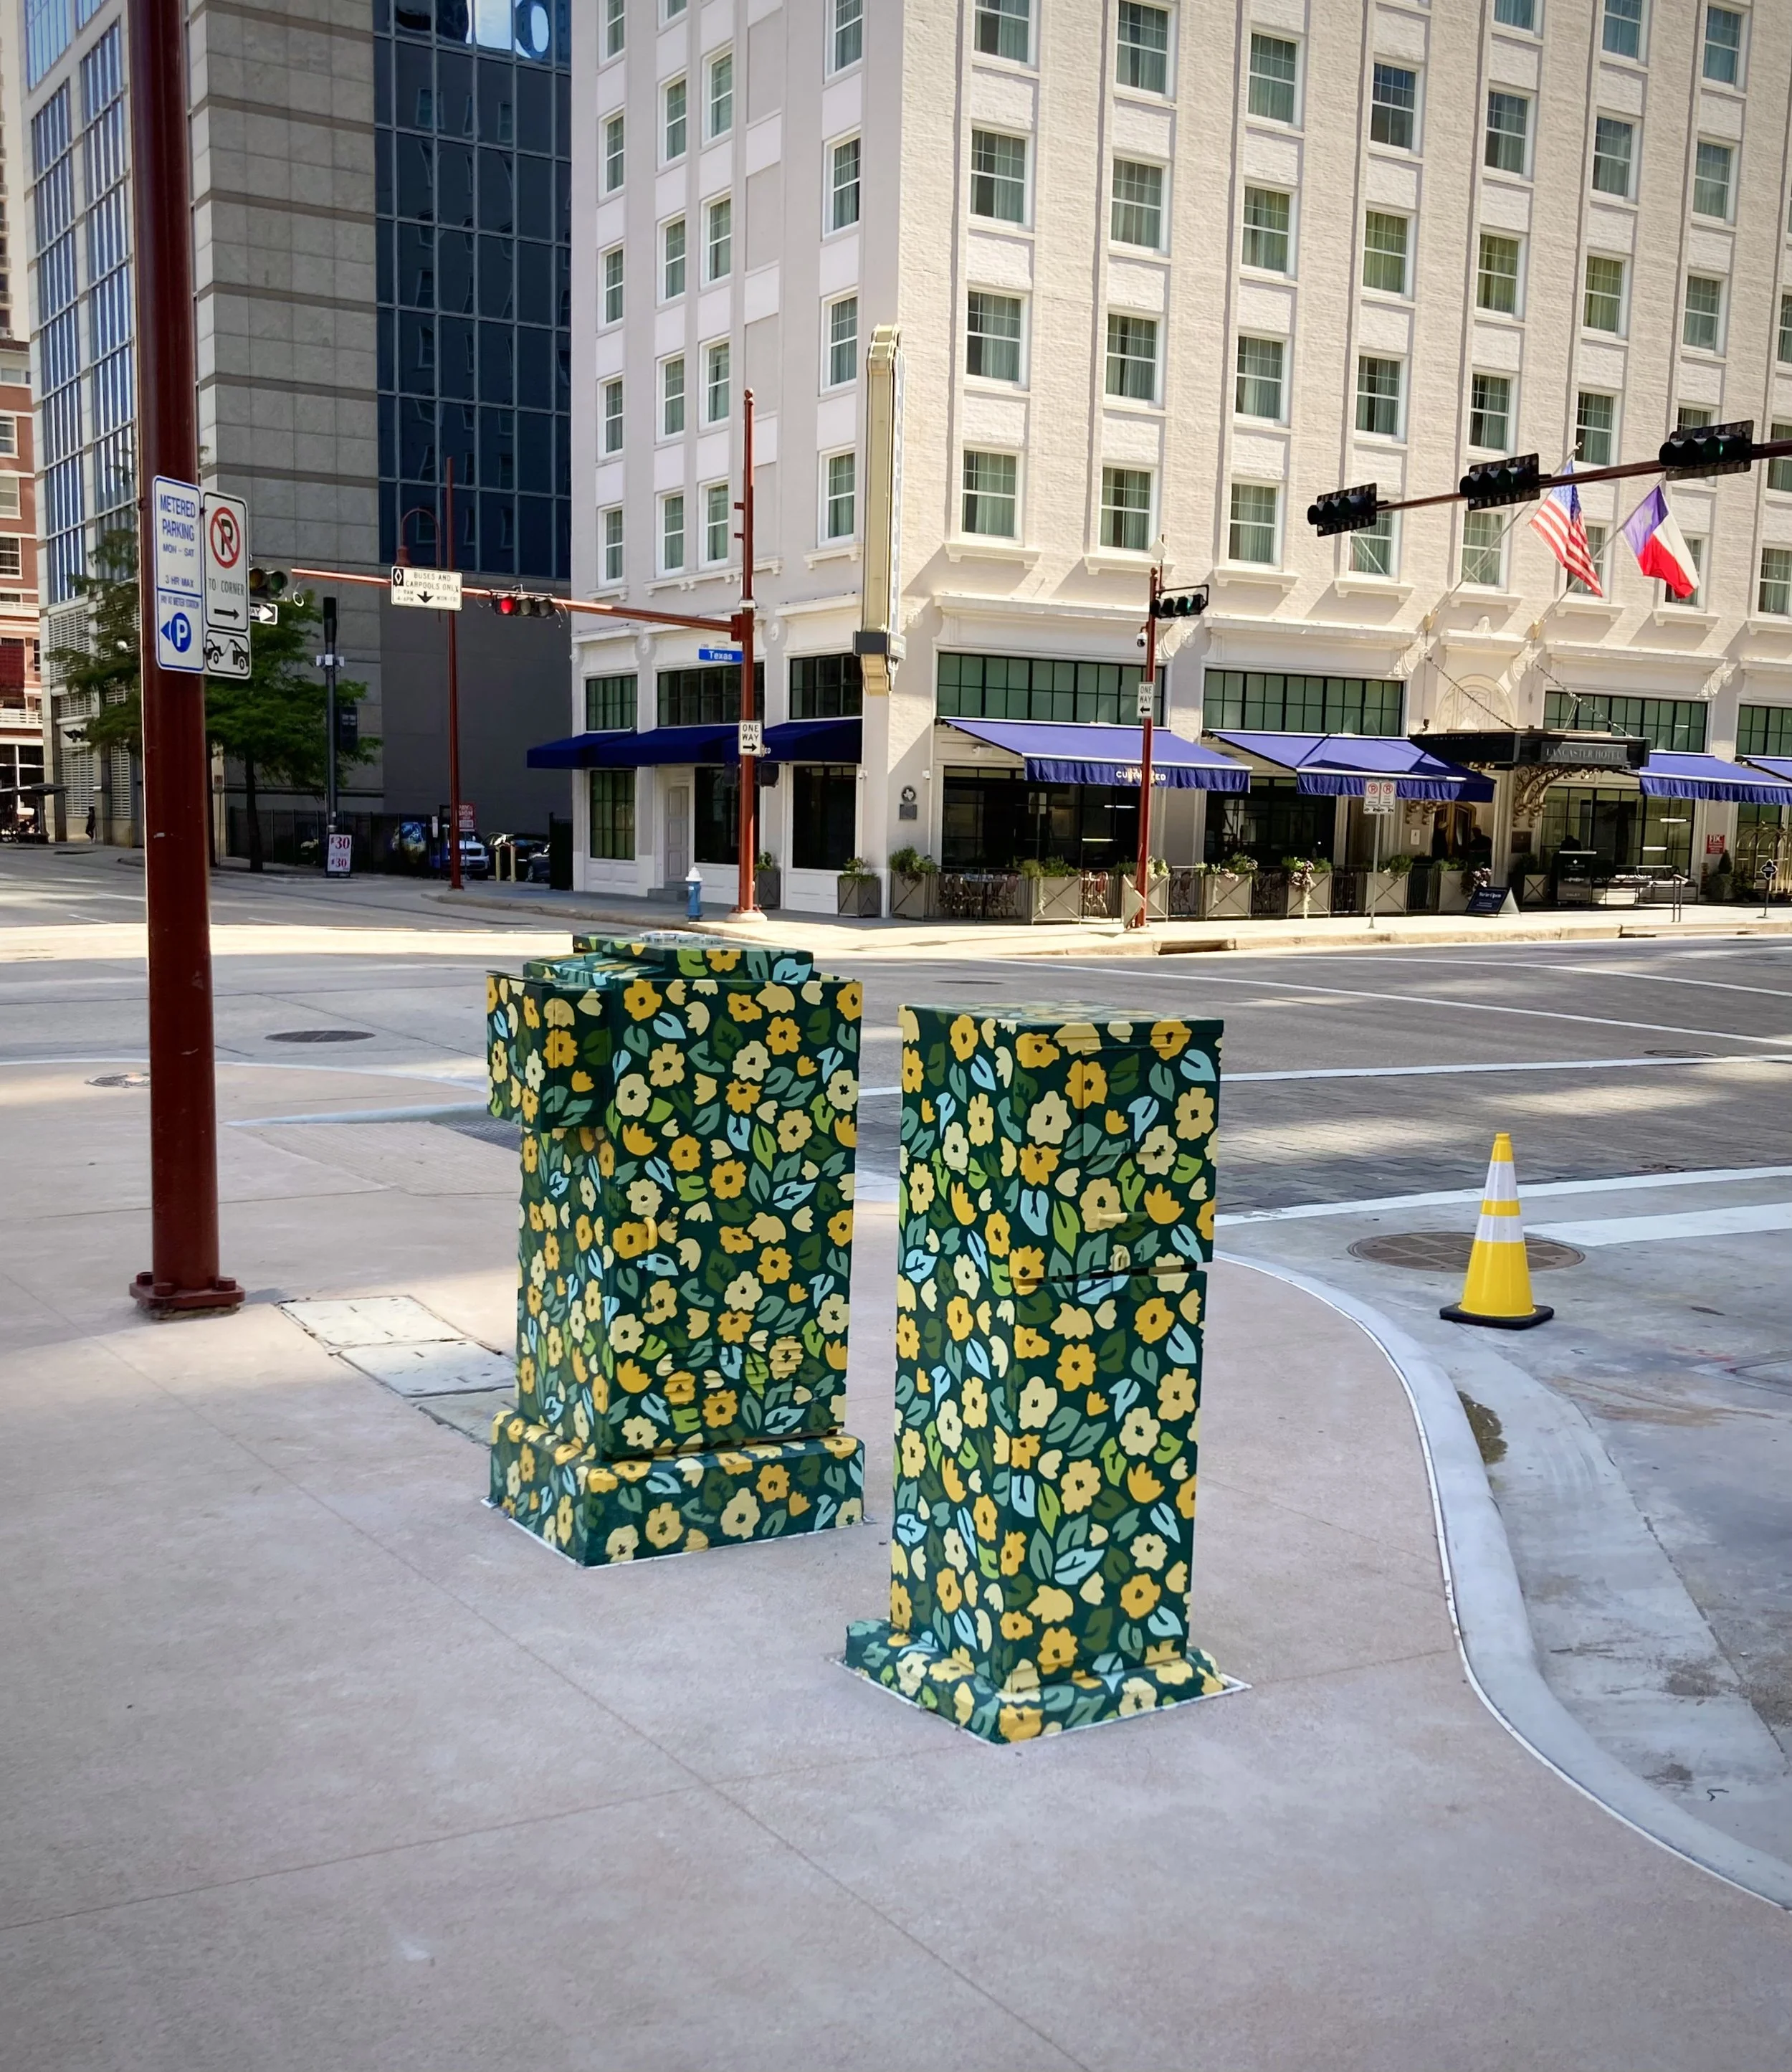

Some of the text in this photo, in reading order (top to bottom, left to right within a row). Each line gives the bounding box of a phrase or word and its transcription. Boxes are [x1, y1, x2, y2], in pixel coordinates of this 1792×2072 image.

[160, 494, 196, 518] METERED
[162, 518, 195, 541] PARKING
[163, 543, 176, 553] MON
[184, 548, 194, 557] SAT
[165, 574, 194, 588] 3 HR MAX
[414, 571, 435, 580] BUSES
[208, 577, 244, 597] TO CORNER
[406, 581, 459, 593] CARPOOLS ONLY
[709, 650, 733, 660] Texas
[1140, 685, 1152, 694] ONE
[1546, 748, 1621, 760] LANCASTER HOTEL
